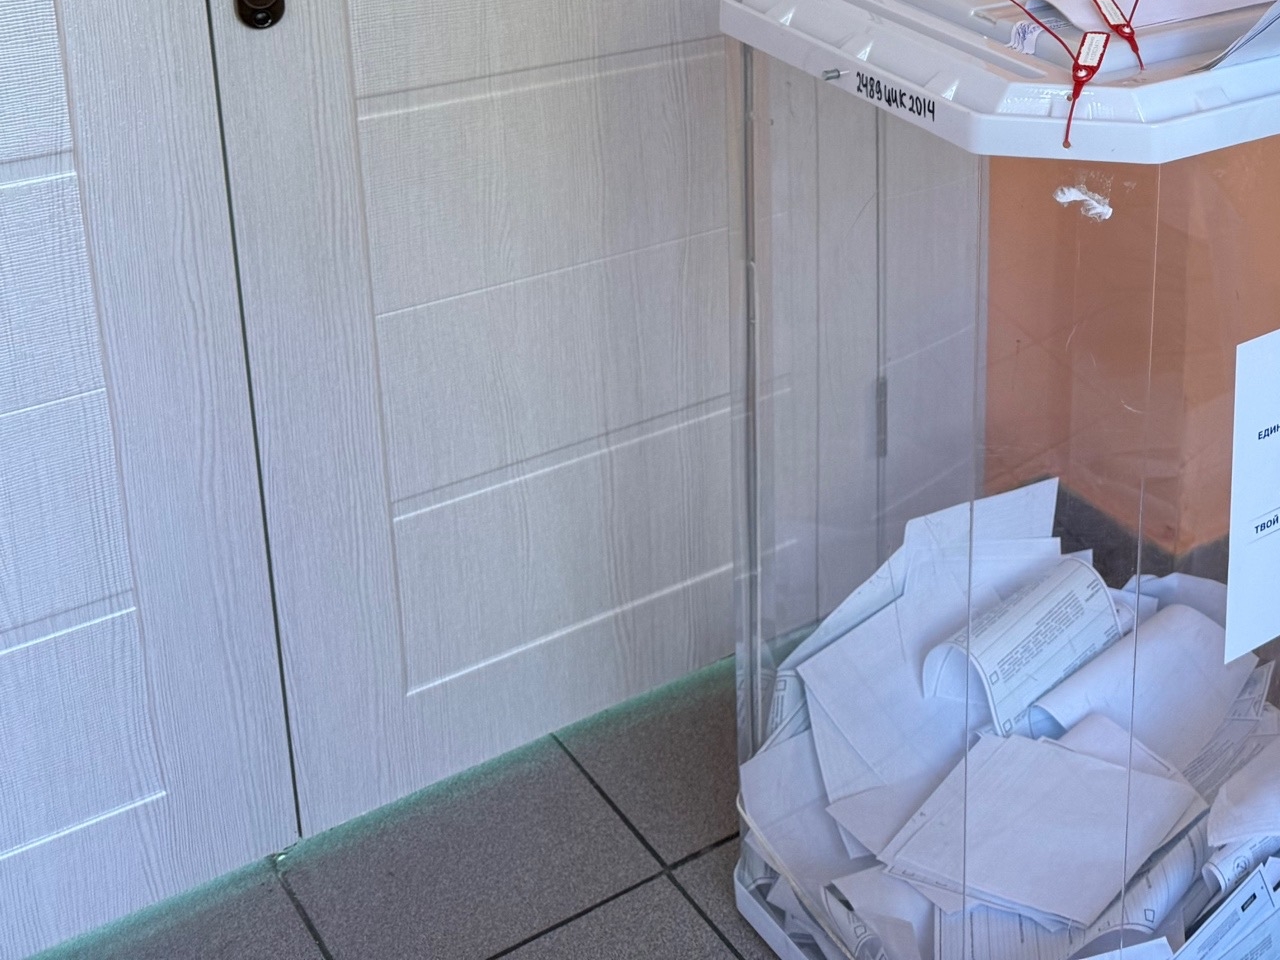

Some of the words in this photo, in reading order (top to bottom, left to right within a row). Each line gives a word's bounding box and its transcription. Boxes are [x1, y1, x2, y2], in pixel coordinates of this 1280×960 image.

[856, 71, 882, 101] 2489
[908, 95, 935, 122] 2014
[1254, 515, 1279, 534] ТВОЙ
